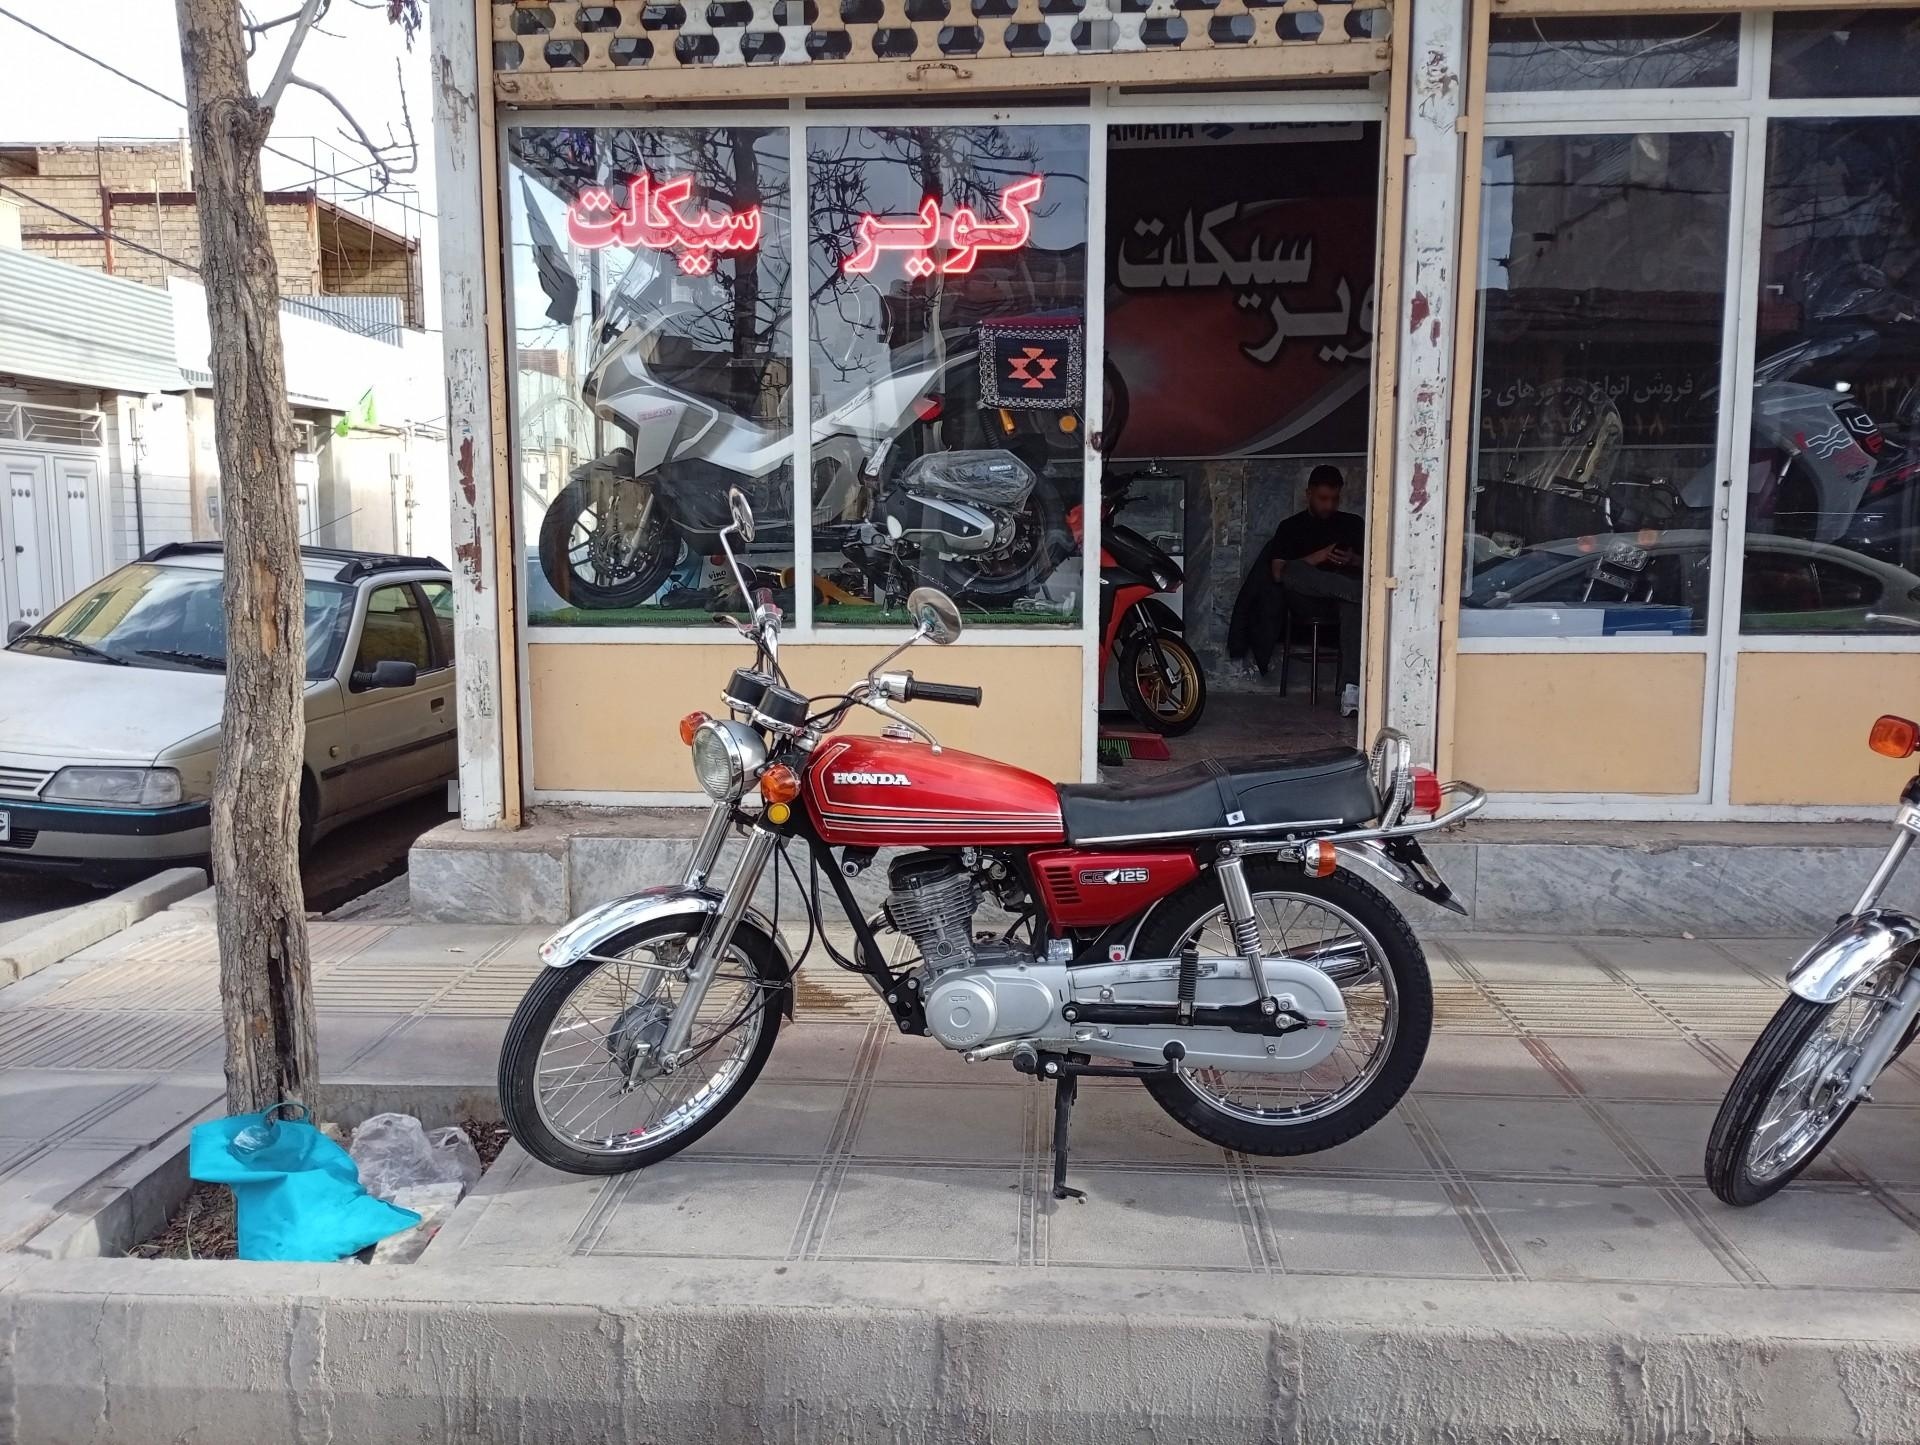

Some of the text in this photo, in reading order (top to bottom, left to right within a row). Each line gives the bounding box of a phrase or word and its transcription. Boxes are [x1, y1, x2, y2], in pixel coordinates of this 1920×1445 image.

[1107, 123, 1194, 141] AMAHA
[567, 174, 1044, 277] کویر سیکلت
[1117, 201, 1312, 309] سیکلت
[1633, 373, 1694, 403] فروش
[832, 773, 912, 786] HONDA
[1081, 870, 1147, 883] CG 125
